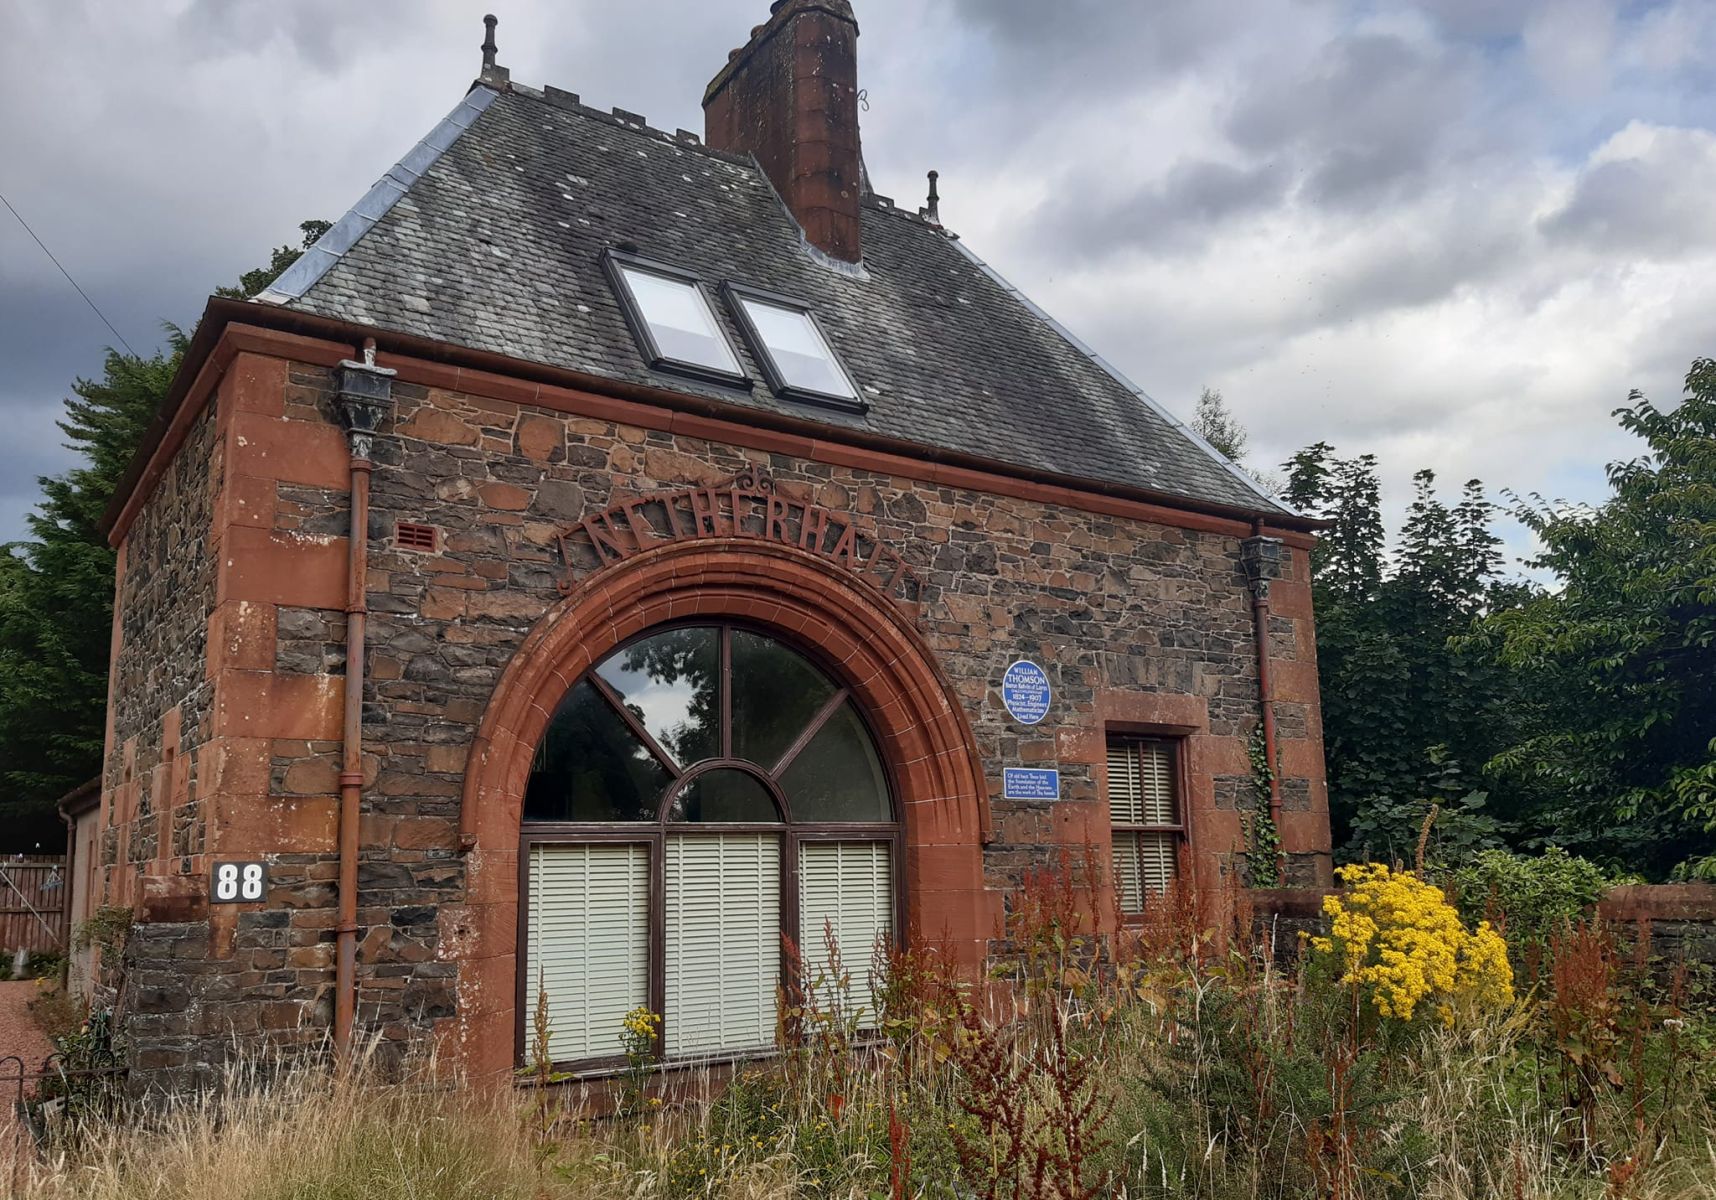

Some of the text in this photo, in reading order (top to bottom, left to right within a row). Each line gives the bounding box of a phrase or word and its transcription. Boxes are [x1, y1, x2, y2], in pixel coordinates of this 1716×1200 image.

[582, 488, 906, 603] NETHERHALL
[1008, 674, 1045, 685] THOMSON
[217, 863, 262, 900] 88
